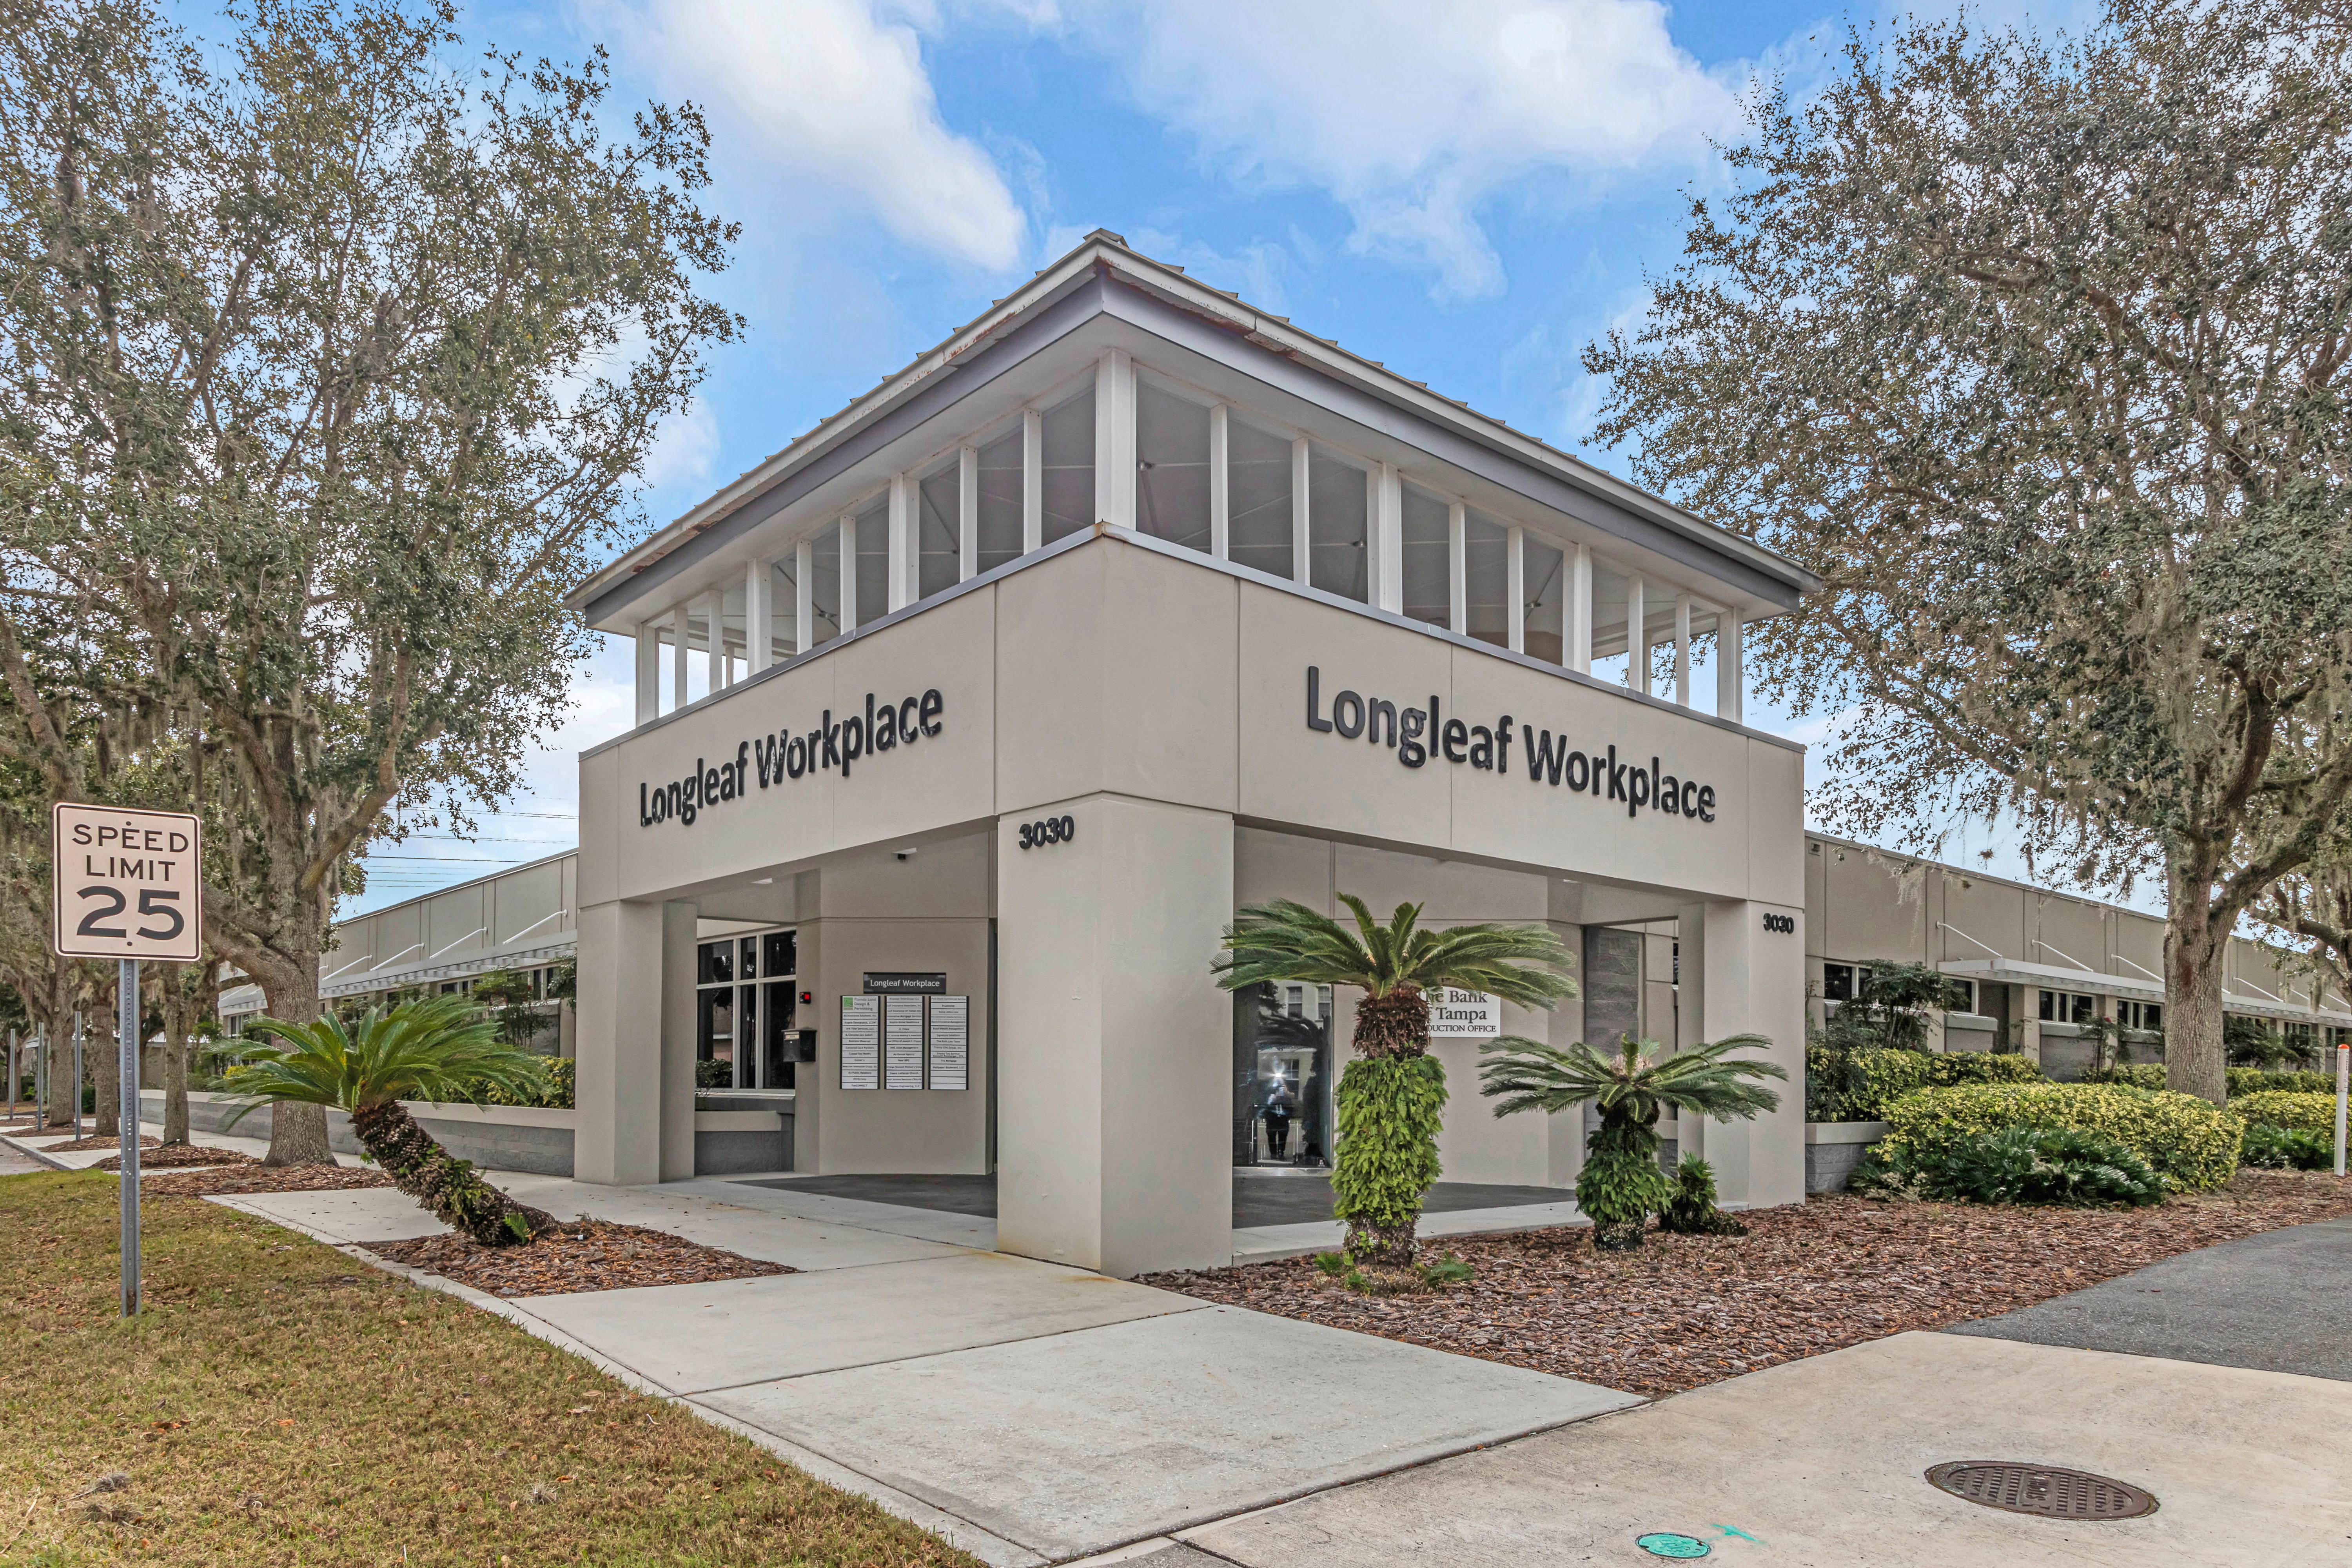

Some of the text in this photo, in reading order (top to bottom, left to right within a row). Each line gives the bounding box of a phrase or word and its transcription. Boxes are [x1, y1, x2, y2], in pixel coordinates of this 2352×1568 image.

[1308, 665, 1715, 822] Longleaf Workplace
[640, 688, 942, 827] Longleaf Workplace
[72, 824, 189, 853] SPEED
[1018, 815, 1074, 849] 3030
[86, 855, 176, 881] LIMIT
[76, 886, 185, 940] 25
[1763, 913, 1794, 934] 3030
[870, 979, 940, 988] Longleaf Workplace
[1419, 990, 1488, 1003] he Bank
[1436, 1006, 1487, 1024] Tampa
